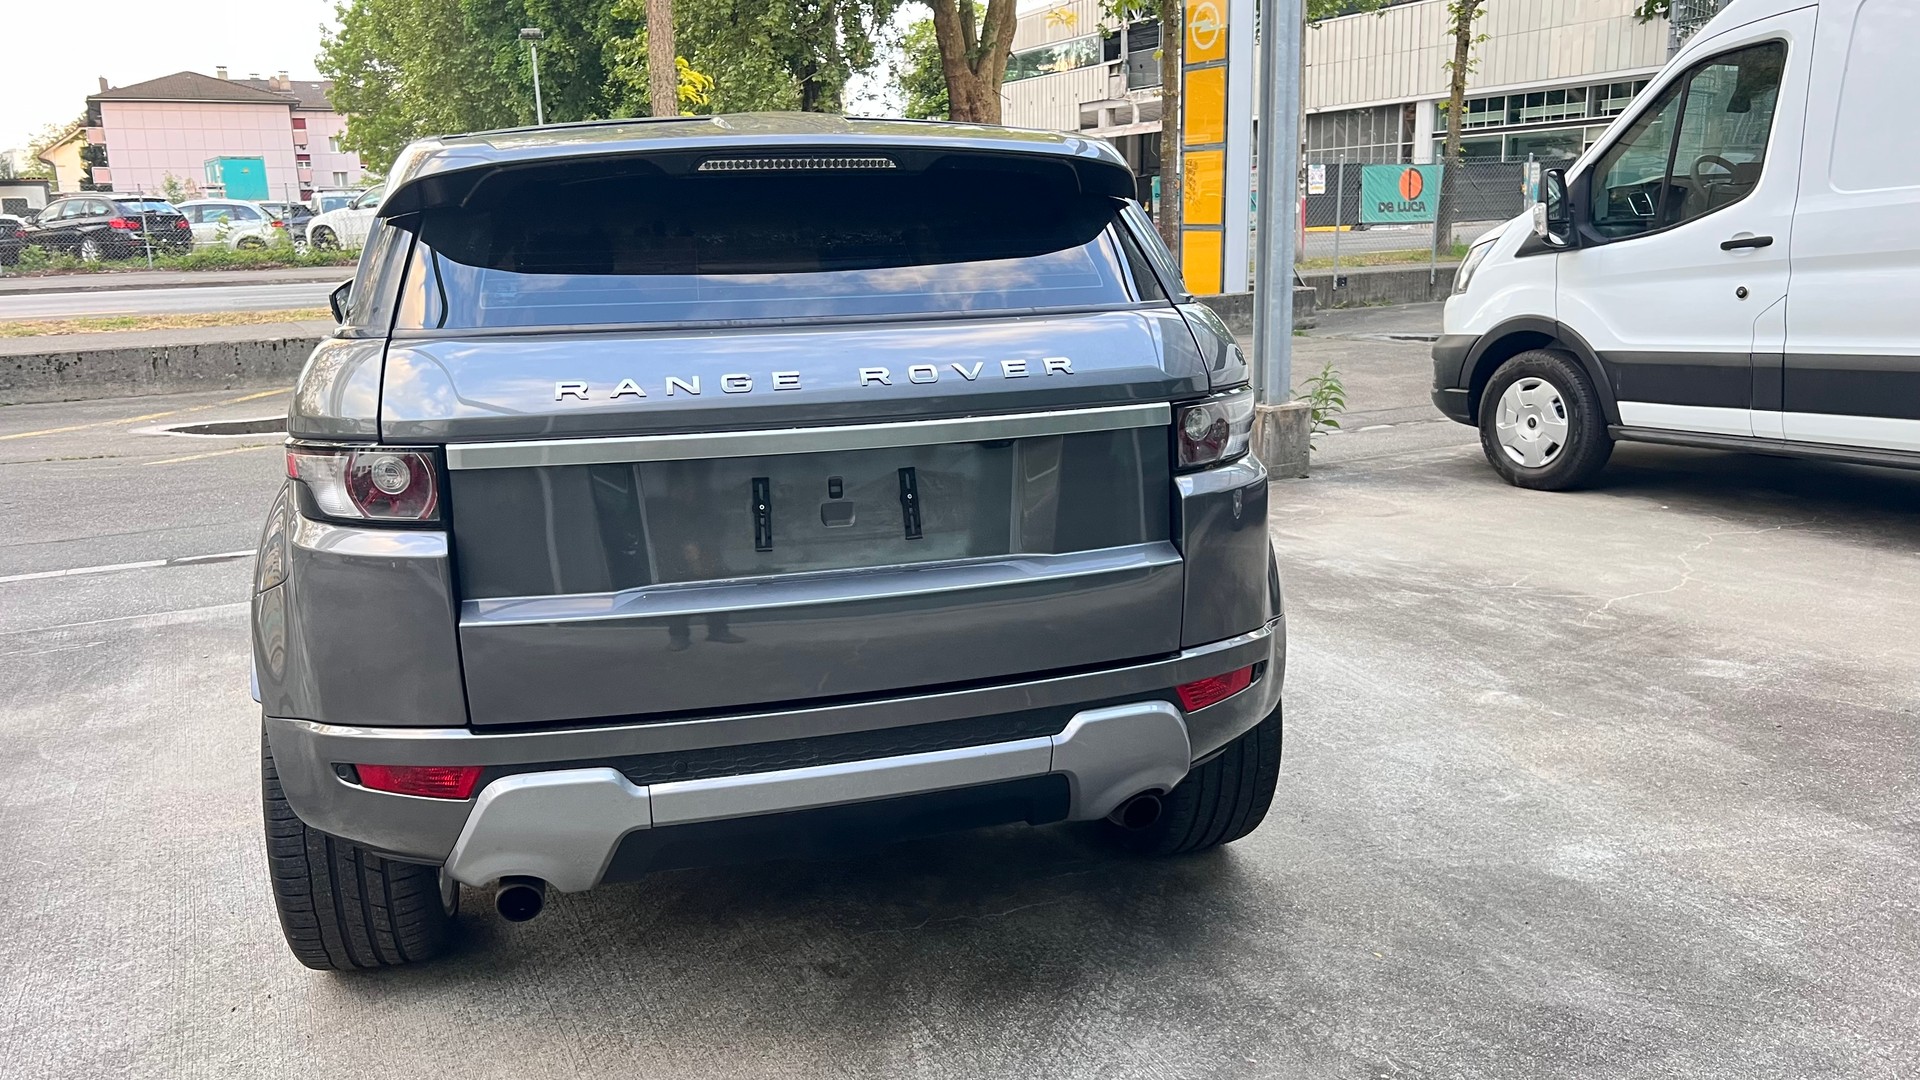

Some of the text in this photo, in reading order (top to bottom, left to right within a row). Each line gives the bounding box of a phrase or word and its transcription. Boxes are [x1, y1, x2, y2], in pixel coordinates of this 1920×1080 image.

[1397, 201, 1426, 213] LUCA
[554, 356, 1075, 401] RANGE ROVER
